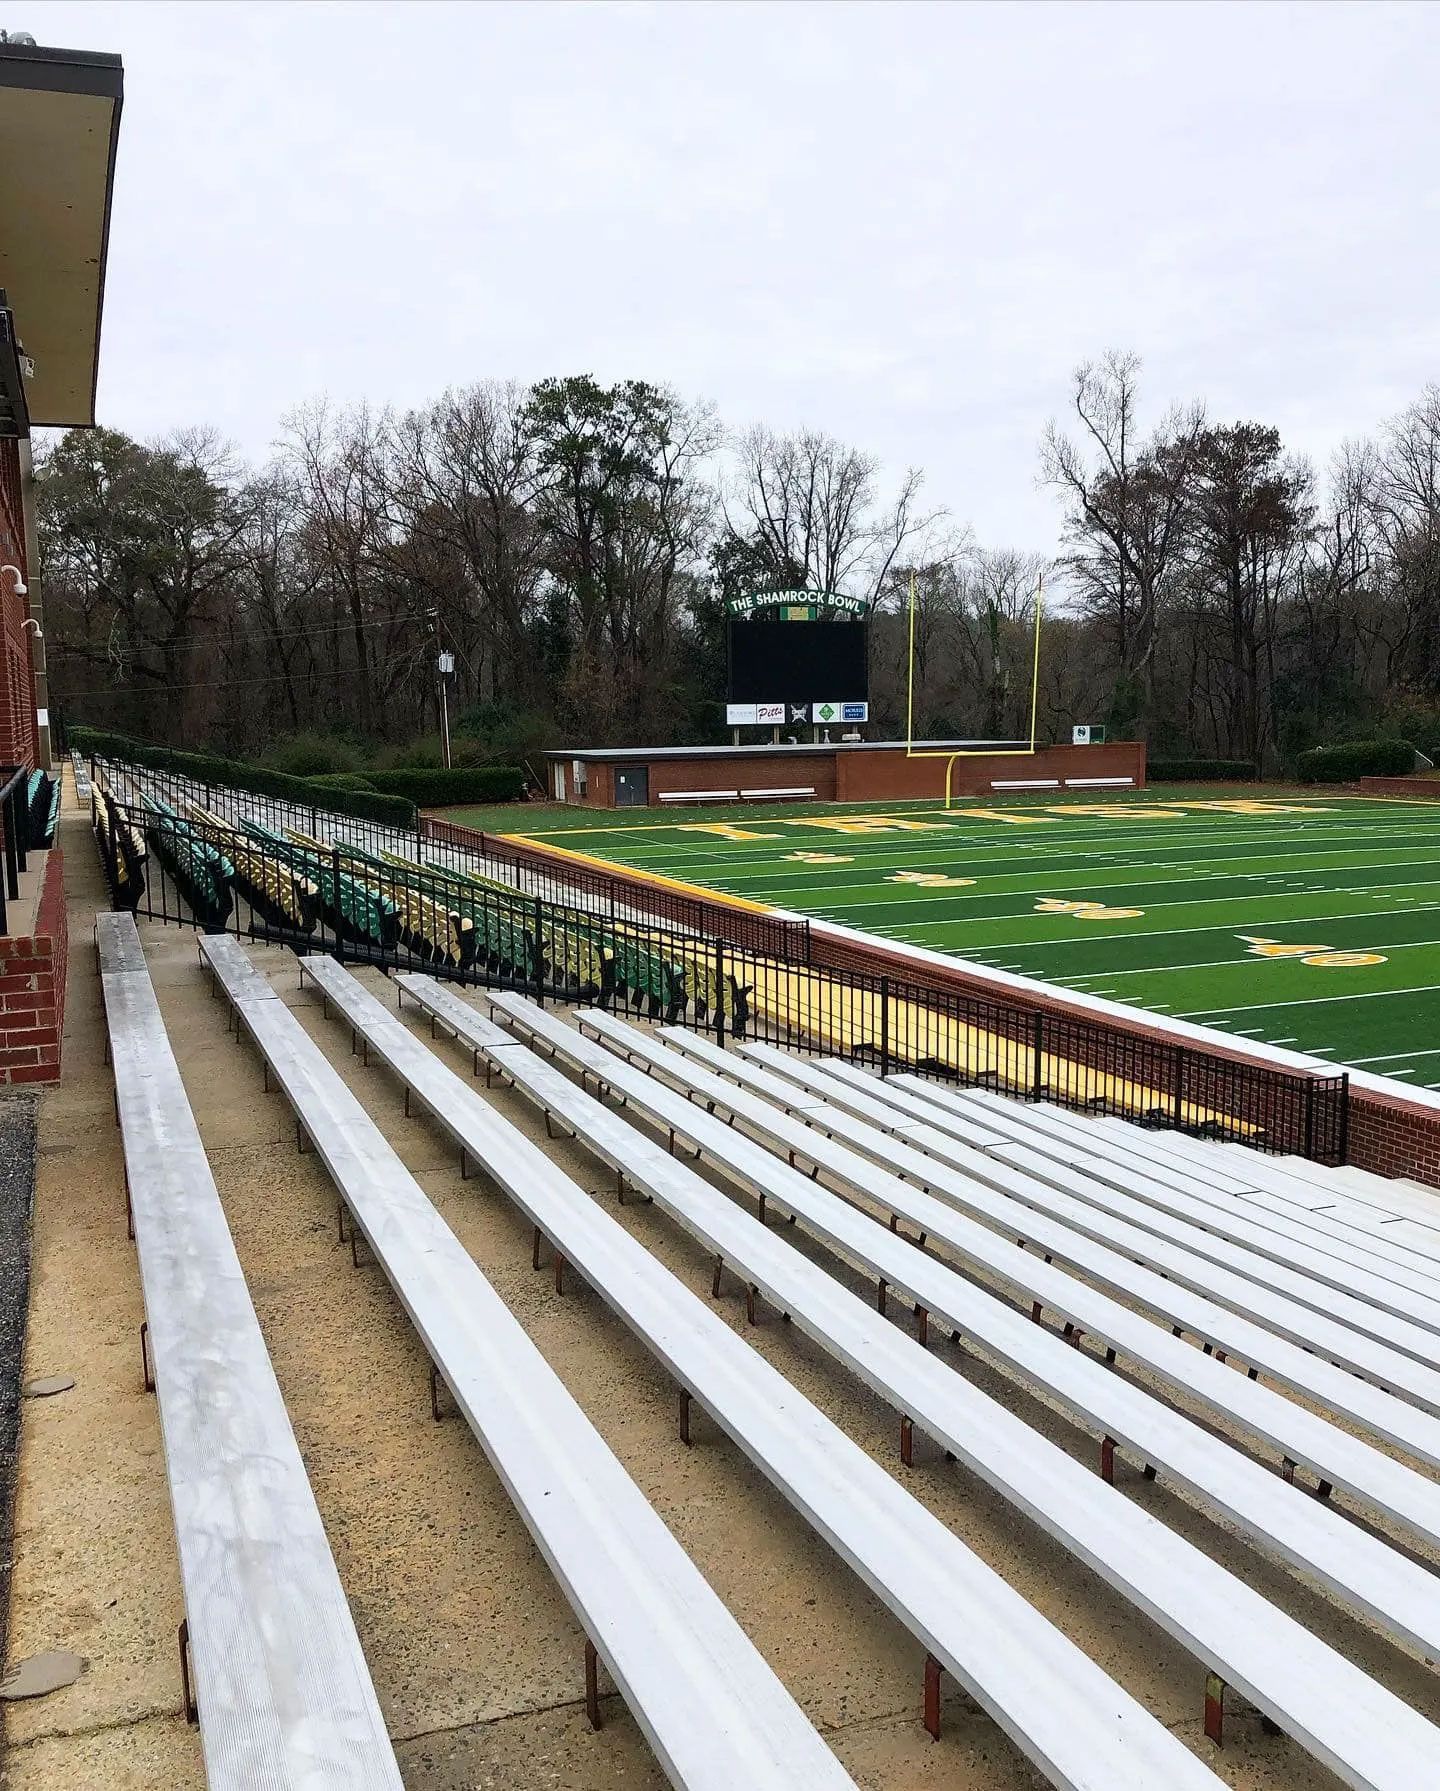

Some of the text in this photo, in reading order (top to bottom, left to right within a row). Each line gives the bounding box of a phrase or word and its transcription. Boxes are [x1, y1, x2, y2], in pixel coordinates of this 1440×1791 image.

[731, 590, 861, 613] THE SHAMROCK BOWL
